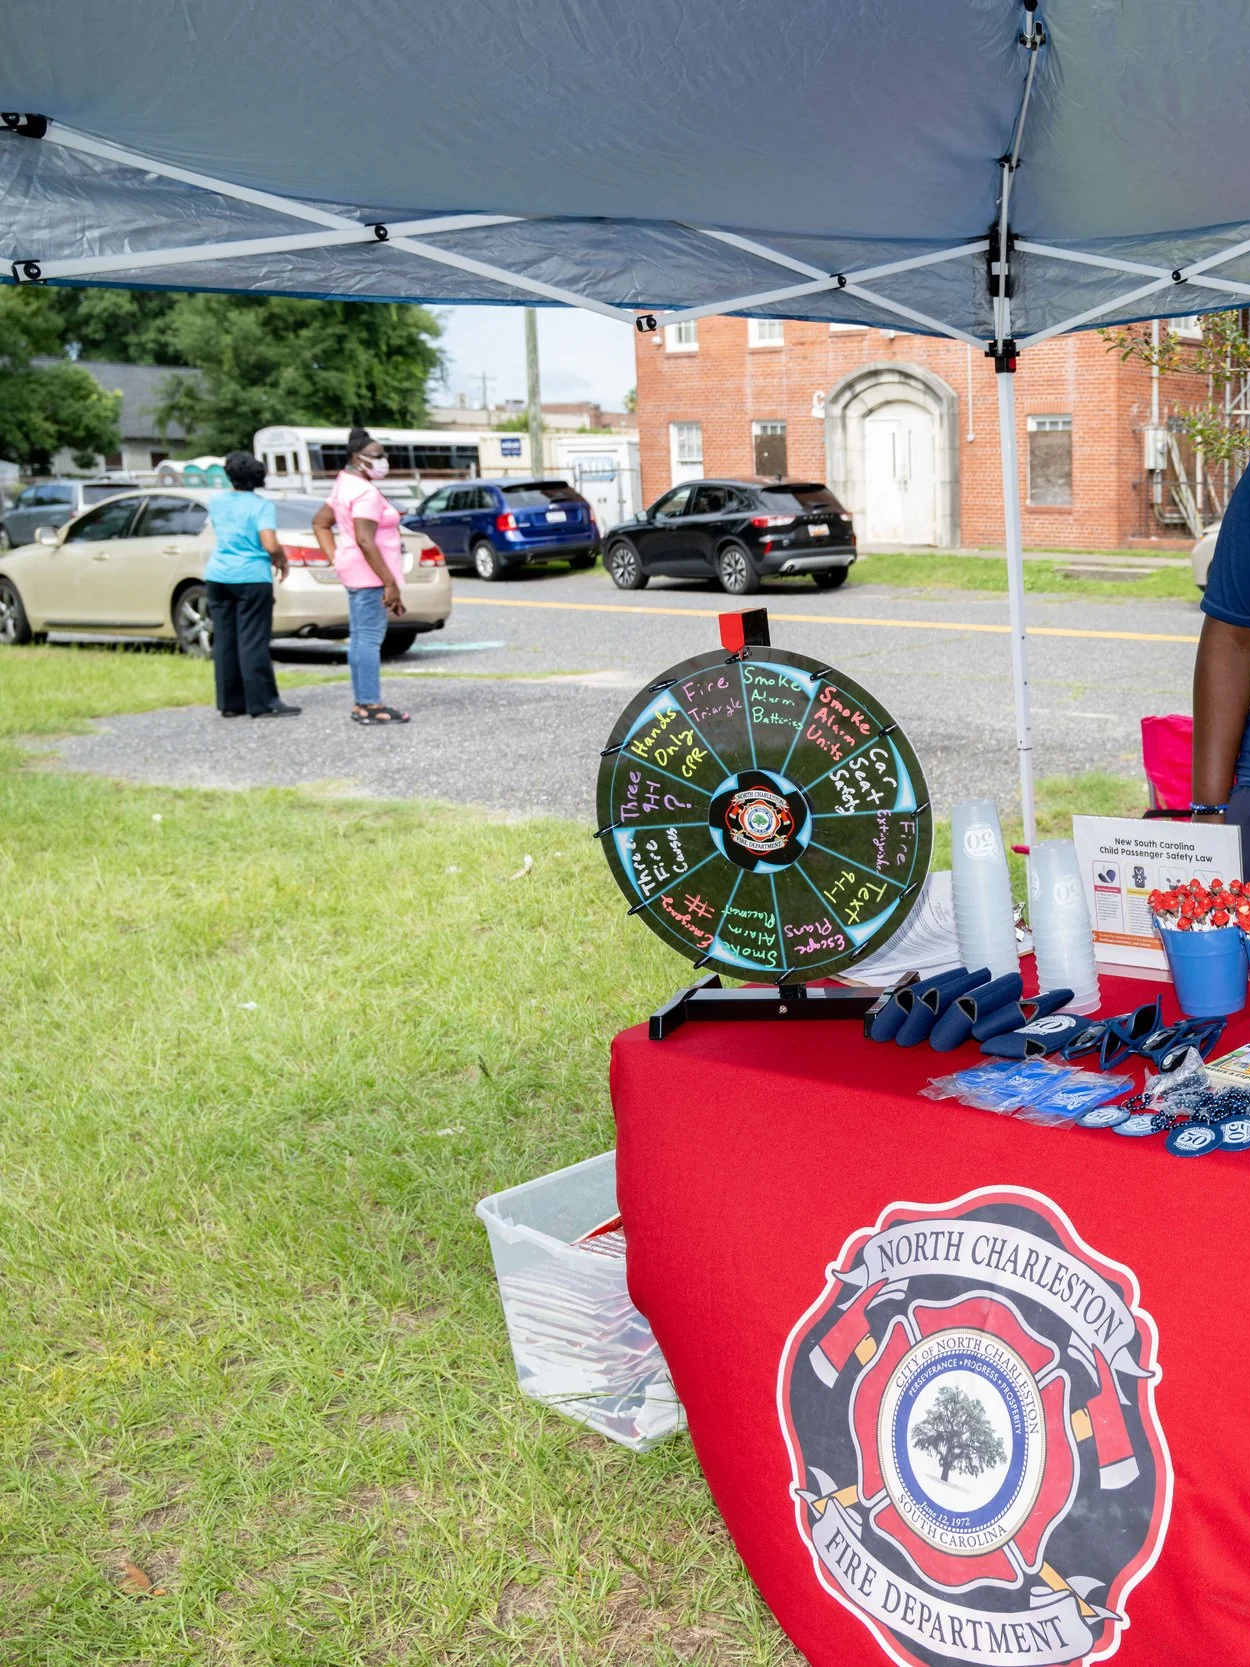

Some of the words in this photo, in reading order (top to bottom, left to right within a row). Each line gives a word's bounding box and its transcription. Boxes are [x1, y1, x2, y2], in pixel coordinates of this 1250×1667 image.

[683, 677, 729, 702] Fire
[743, 667, 801, 691] Smoke
[688, 698, 742, 722] Triangle
[752, 706, 803, 730] Batteries
[814, 708, 855, 746] Alarm
[820, 686, 870, 734] Smoke
[631, 707, 677, 758] Hands
[655, 730, 694, 766] Only
[806, 724, 842, 760] Units
[682, 747, 708, 778] CPR
[849, 757, 884, 804] Seat
[870, 748, 897, 788] Car
[620, 770, 642, 822] Three
[664, 794, 692, 811] ?
[754, 792, 784, 805] CHARLESTON
[830, 770, 860, 814] Safety
[646, 839, 670, 882] Fire
[666, 827, 688, 873] Causes
[736, 836, 748, 846] FIRE
[748, 842, 782, 850] DEPARTMENT
[896, 822, 916, 866] Fire
[1100, 846, 1118, 854] Child
[1121, 848, 1164, 860] Passenger
[1166, 852, 1192, 862] Safety
[1196, 854, 1212, 862] Law
[1134, 840, 1157, 848] South
[1160, 842, 1195, 850] Carolina
[661, 894, 714, 948] Emergency
[684, 894, 715, 918] #
[844, 882, 888, 925] Text
[728, 924, 776, 946] Alarm
[784, 918, 832, 938] Plans
[794, 934, 845, 954] Escape
[724, 941, 778, 968] Smoke
[1180, 1132, 1207, 1145] 50
[1228, 1124, 1245, 1140] 50
[878, 1231, 964, 1273] NORTH
[972, 1234, 1124, 1344] CHARLESTON
[896, 1356, 922, 1388] CITY
[922, 1346, 934, 1360] OF
[937, 1337, 982, 1352] NORTH
[985, 1343, 1039, 1434] CHARLESTON
[908, 1359, 957, 1397] PERSEVERANCE
[964, 1359, 998, 1382] PROGRESS
[1000, 1383, 1022, 1434] PROSPERITY
[898, 1494, 936, 1538] SOUTH
[940, 1524, 1008, 1548] CAROLINA
[920, 1501, 938, 1519] June
[938, 1516, 949, 1526] 12,
[952, 1518, 970, 1526] 1972
[824, 1527, 876, 1596] FIRE
[881, 1580, 1069, 1653] DEPARTMENT
